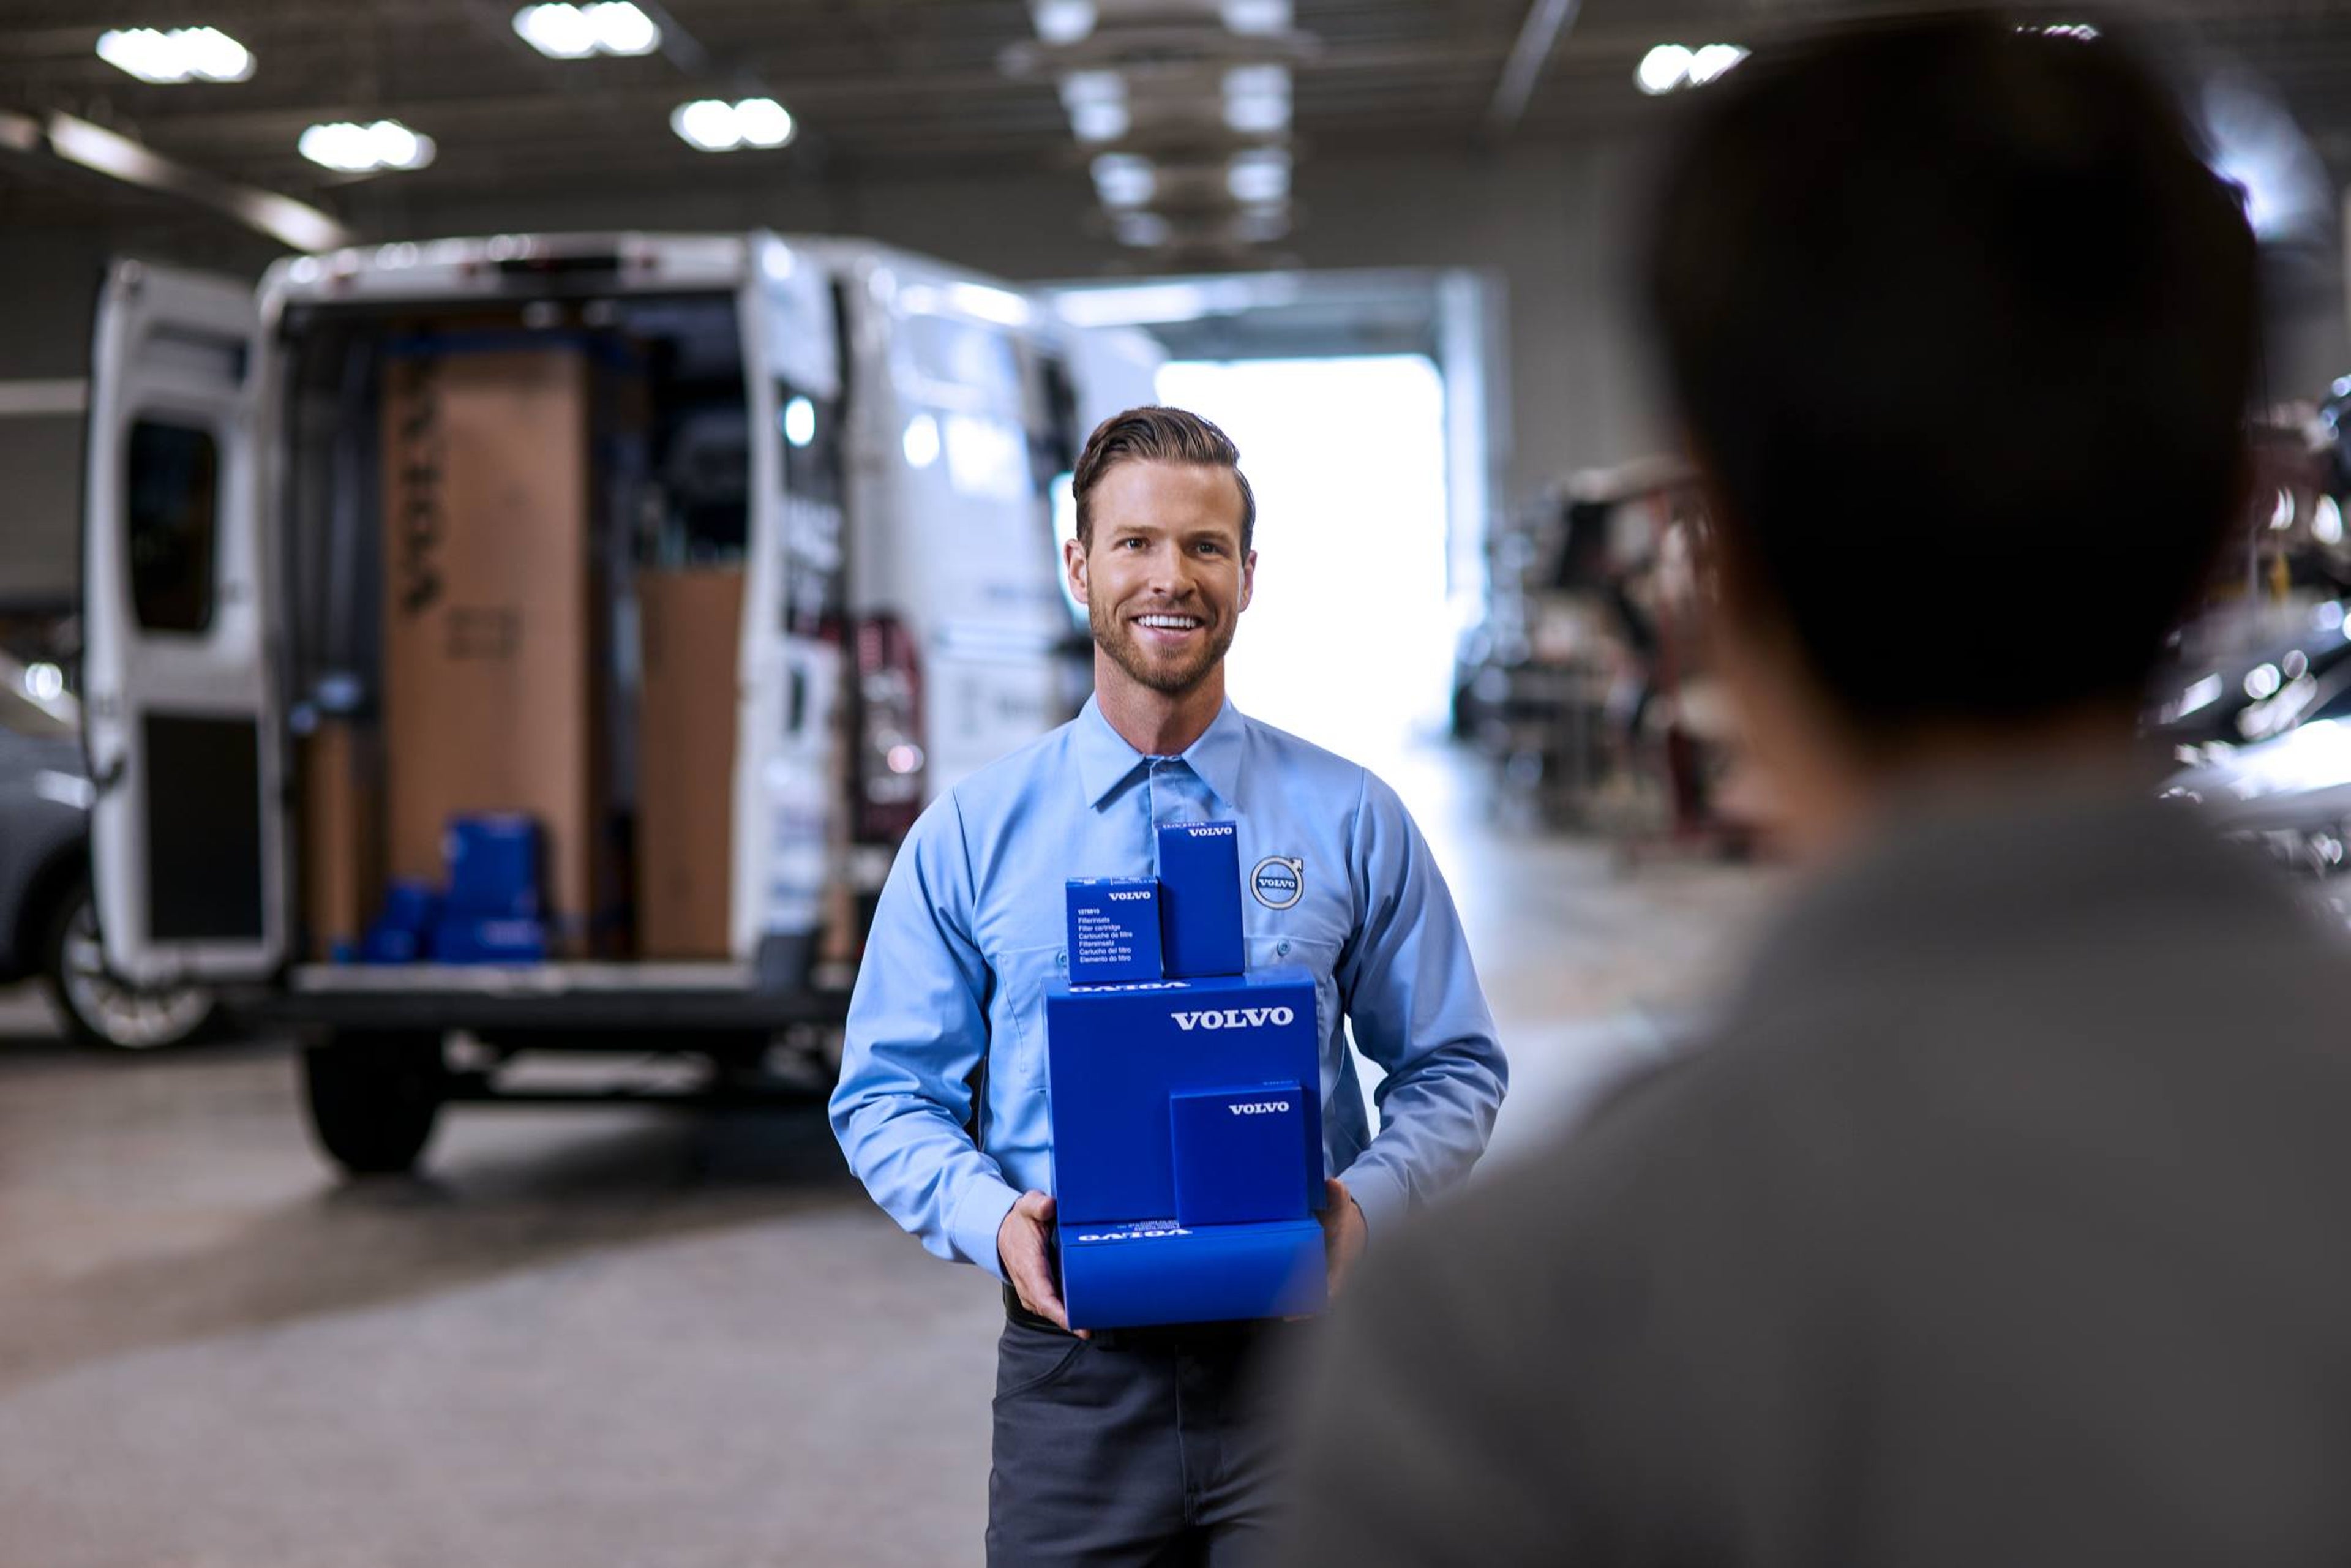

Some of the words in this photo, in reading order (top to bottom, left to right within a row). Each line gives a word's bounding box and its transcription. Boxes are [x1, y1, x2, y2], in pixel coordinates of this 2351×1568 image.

[1188, 827, 1232, 837] VOLVO
[1258, 879, 1295, 888] VOLVO
[1108, 891, 1151, 901] VOLVO
[1069, 982, 1191, 992] VOLVO
[1171, 1007, 1294, 1030] VOLVO
[1229, 1101, 1289, 1115] VOLVO
[1078, 1229, 1193, 1242] VOLVO
